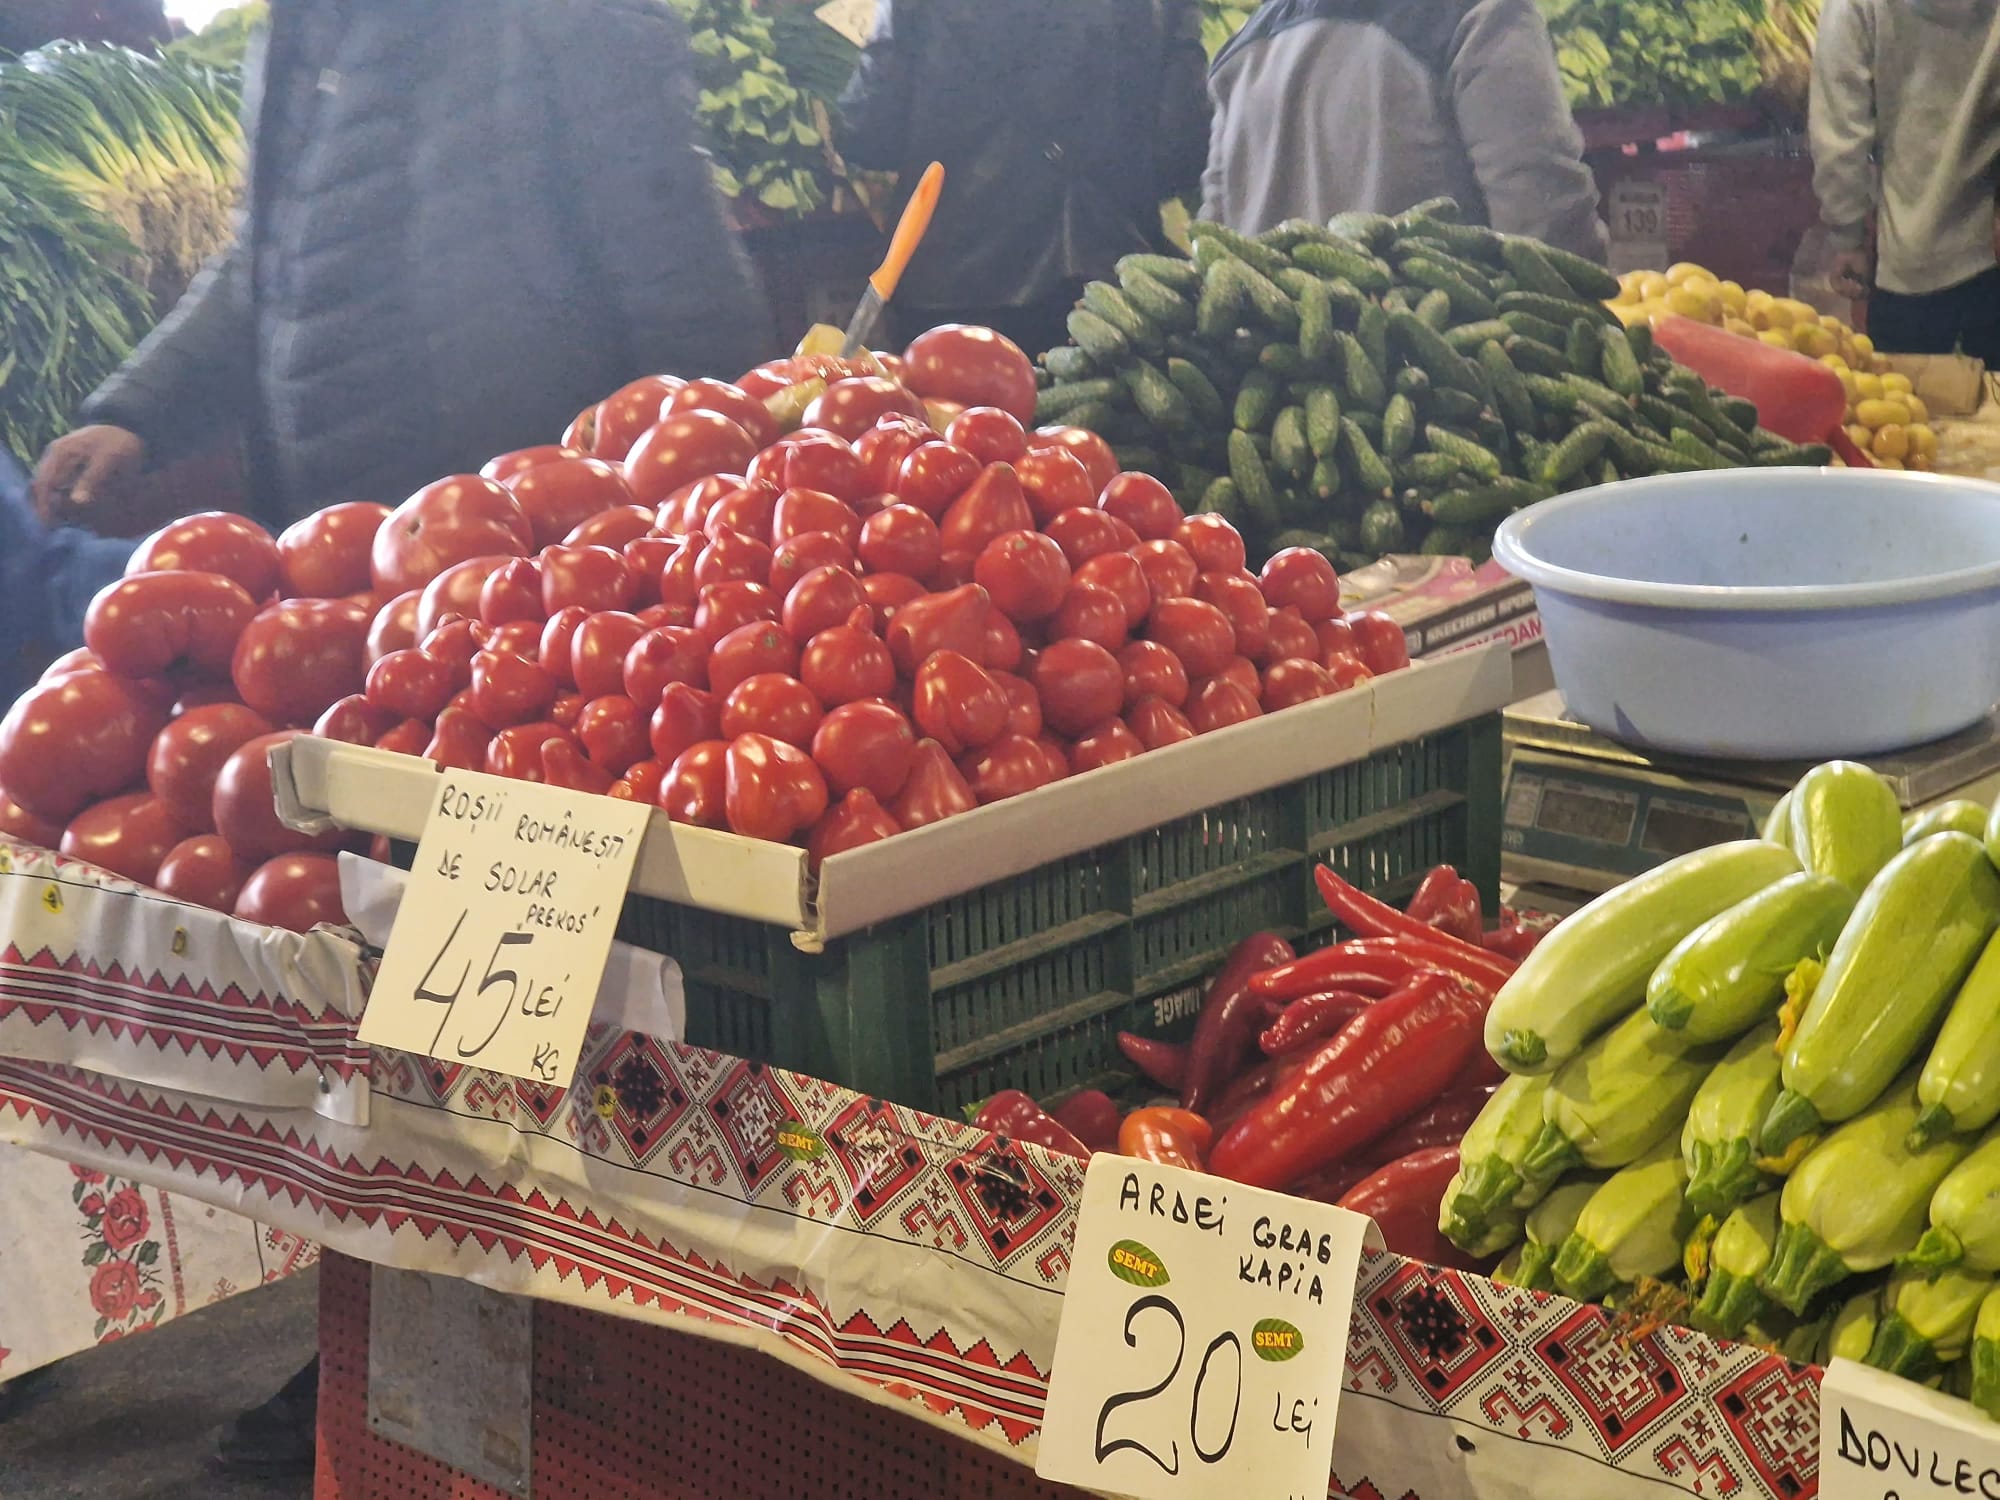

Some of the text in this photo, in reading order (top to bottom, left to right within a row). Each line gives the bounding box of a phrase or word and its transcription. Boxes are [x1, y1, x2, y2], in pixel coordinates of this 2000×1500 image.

[437, 848, 557, 899] DE SOLAR
[414, 908, 534, 1058] 45
[530, 1042, 559, 1081] KG
[777, 1131, 817, 1152] SEMT
[1112, 1247, 1159, 1280] SEMT
[1254, 1330, 1295, 1349] SEMT
[1094, 1294, 1242, 1476] 20
